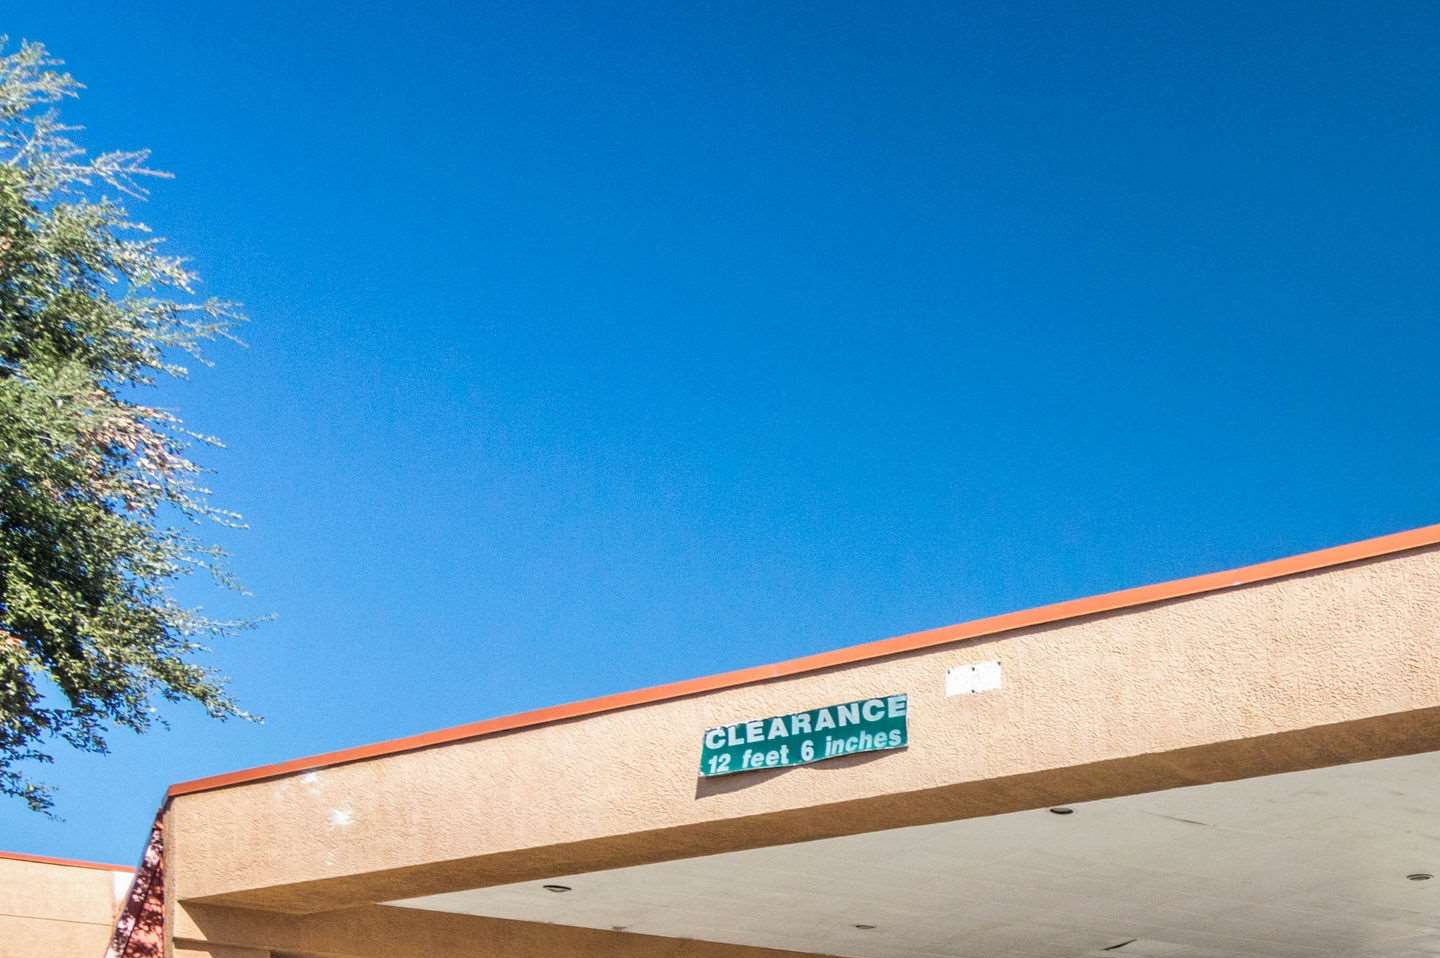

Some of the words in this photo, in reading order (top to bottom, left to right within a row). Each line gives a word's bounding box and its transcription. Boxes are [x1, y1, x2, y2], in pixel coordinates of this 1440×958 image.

[705, 697, 907, 749] CLEARANCE
[708, 754, 731, 773] 12
[742, 744, 790, 768] feet
[800, 740, 815, 762] 6
[825, 729, 901, 756] inches
